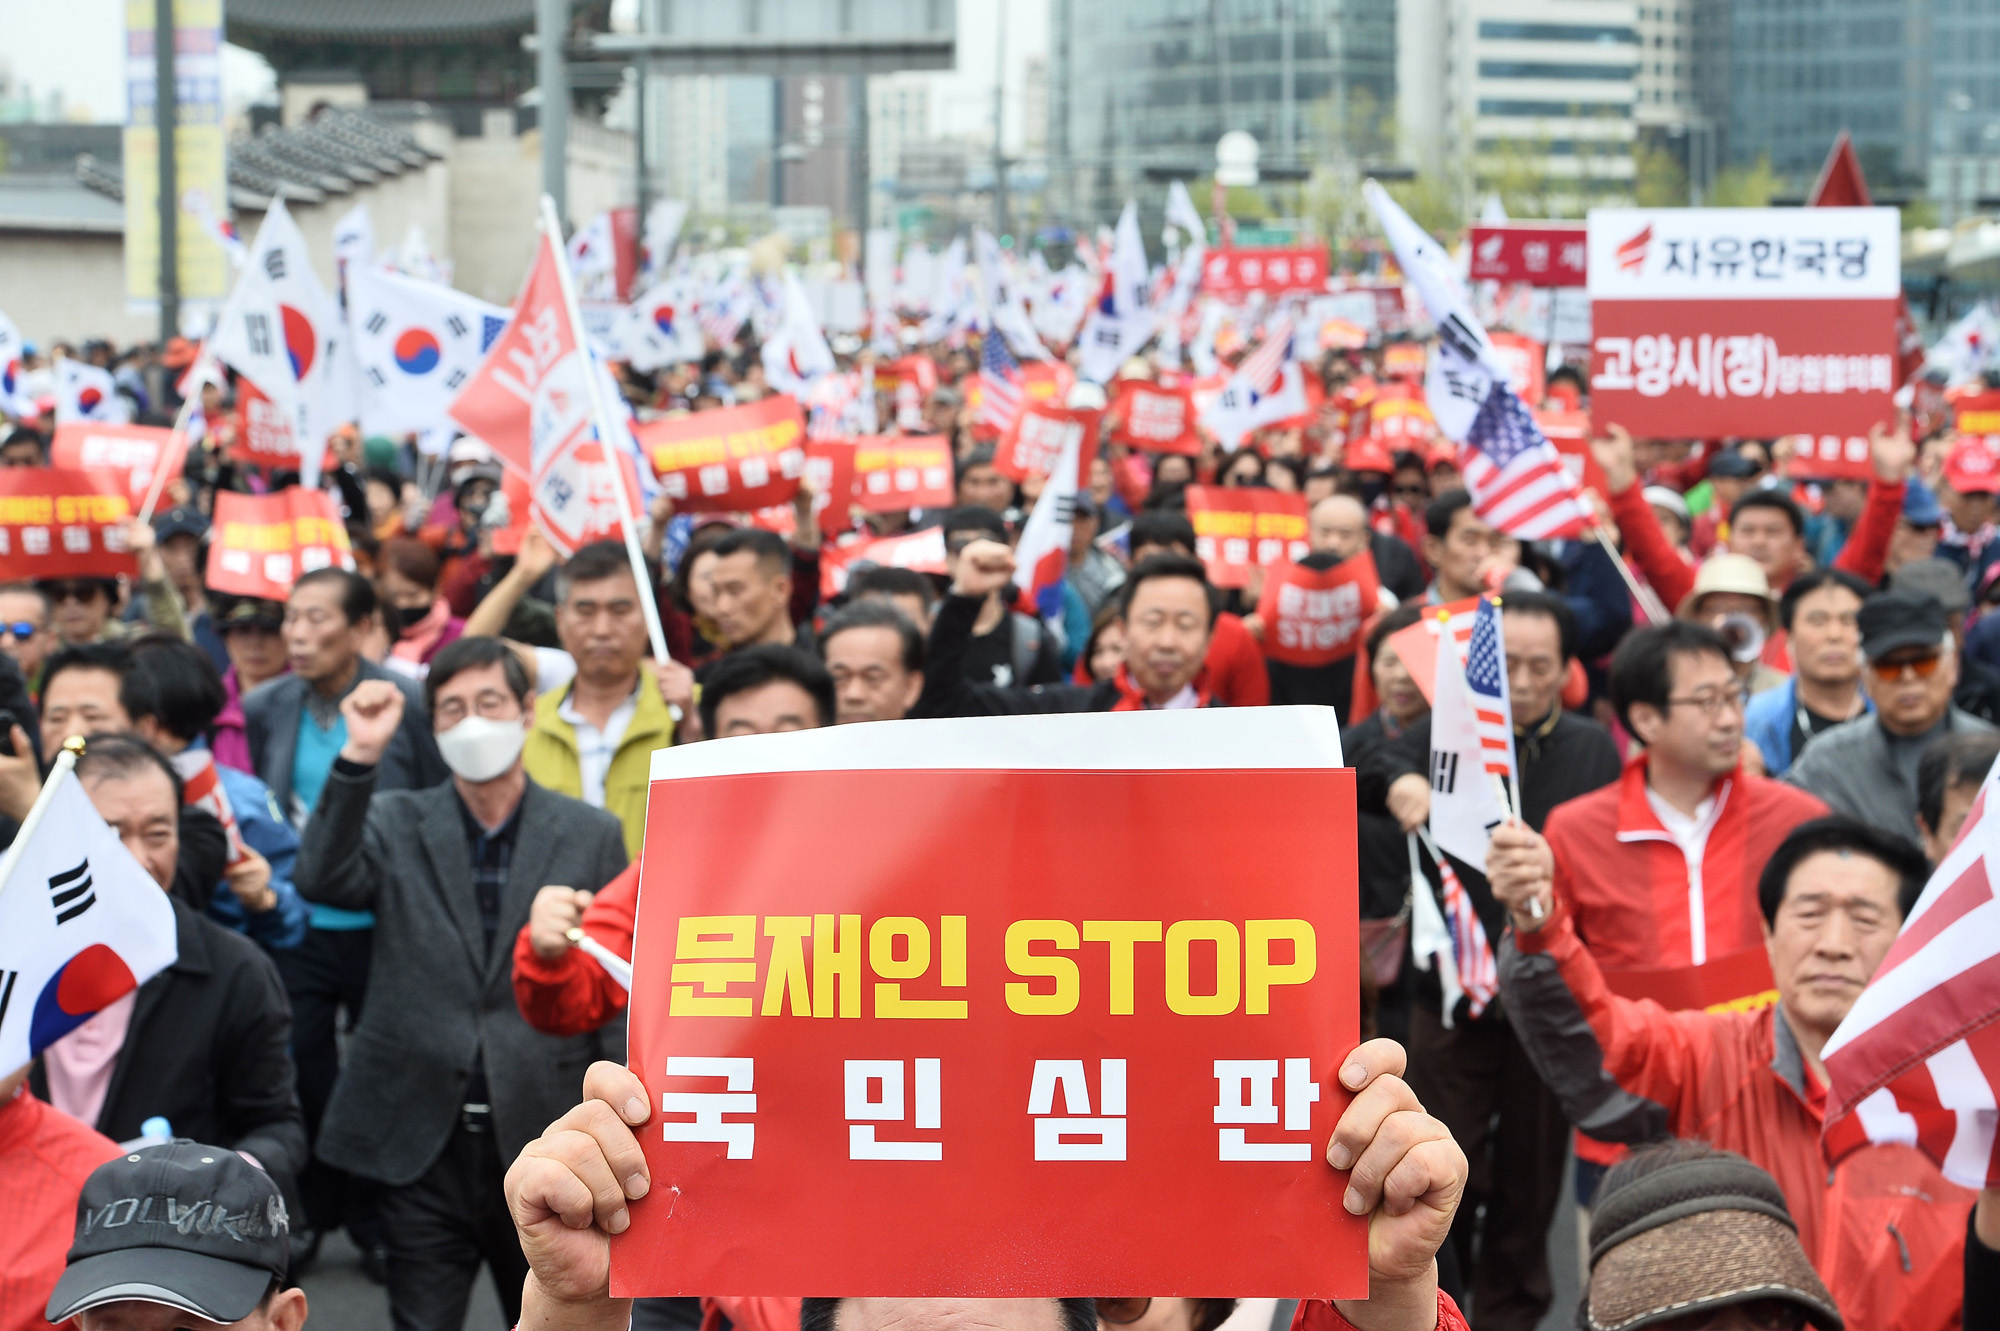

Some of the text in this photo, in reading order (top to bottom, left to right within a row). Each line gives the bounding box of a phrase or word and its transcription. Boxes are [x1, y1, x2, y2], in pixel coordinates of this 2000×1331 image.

[1663, 237, 1872, 280] 자유한국당
[1591, 333, 1778, 398] 고양시(정)
[1278, 581, 1361, 620] 문재인
[1277, 614, 1361, 651] STOP
[669, 913, 1317, 1019] 문재인 STOP
